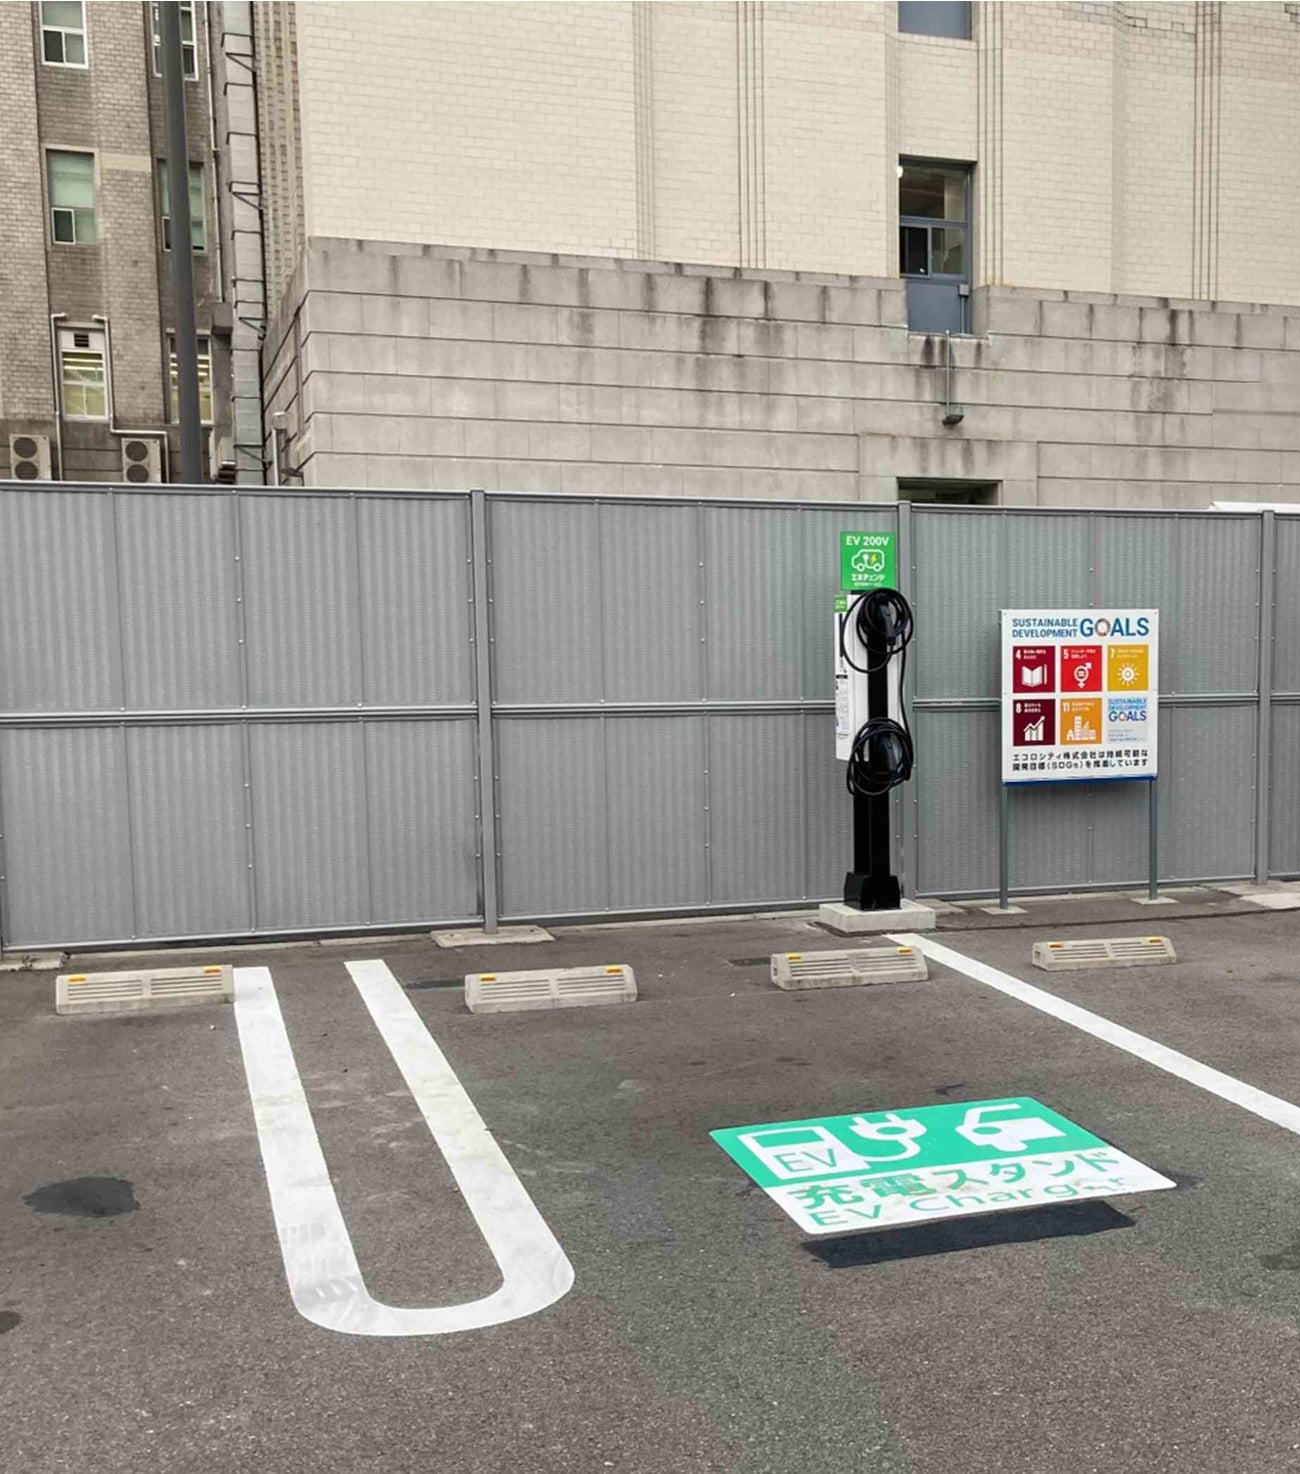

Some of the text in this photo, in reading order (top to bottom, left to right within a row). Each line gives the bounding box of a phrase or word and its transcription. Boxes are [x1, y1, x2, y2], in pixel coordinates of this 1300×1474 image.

[846, 535, 890, 546] EV 200V
[1012, 618, 1078, 628] SUSTAINABLE
[1079, 617, 1149, 637] GOALS
[1012, 628, 1078, 638] DEVELOPMENT
[1015, 649, 1022, 660] 4
[1063, 648, 1069, 659] 5
[1015, 703, 1022, 713] 8
[1063, 702, 1070, 712] 11
[1108, 710, 1147, 721] GOALS
[778, 1148, 839, 1173] EV
[789, 1150, 1123, 1210] 充電スタンド
[808, 1204, 894, 1227] EV
